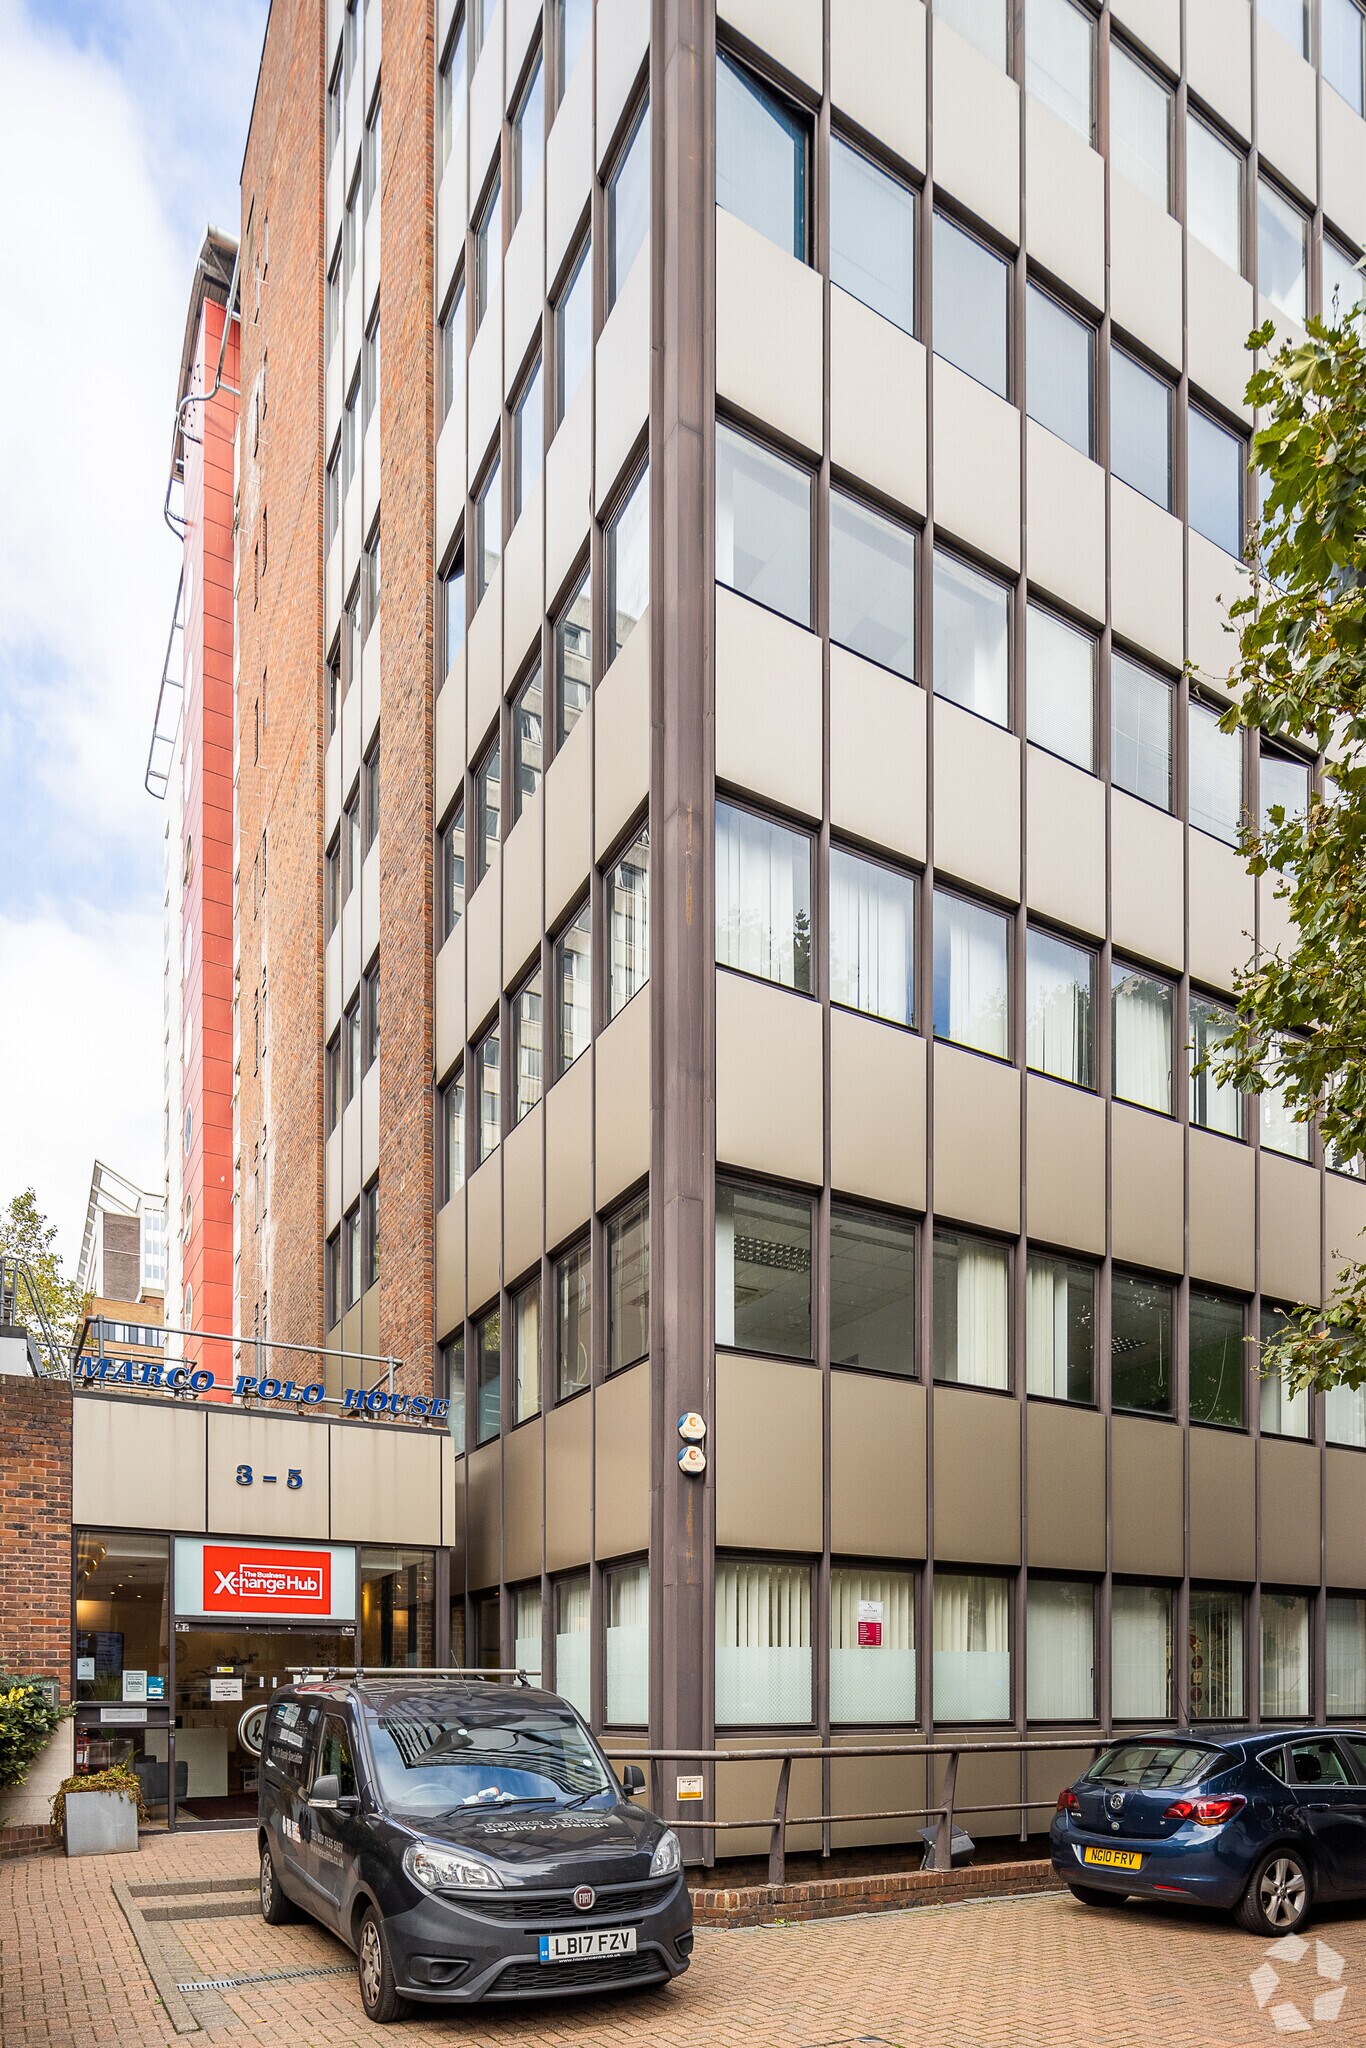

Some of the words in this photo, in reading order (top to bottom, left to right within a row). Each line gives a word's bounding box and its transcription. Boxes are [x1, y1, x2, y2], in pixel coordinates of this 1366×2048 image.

[77, 1356, 215, 1392] MARCO
[232, 1374, 326, 1405] POLO
[342, 1388, 451, 1419] HOUSE
[235, 1464, 254, 1486] 3
[286, 1468, 304, 1490] 5
[213, 1570, 286, 1595] Xchange
[286, 1575, 318, 1591] Hub
[476, 1820, 544, 1830] Telco
[484, 1825, 537, 1834] Quality
[541, 1823, 558, 1831] by
[1091, 1848, 1112, 1863] NG10
[1113, 1851, 1136, 1866] FRV
[579, 1892, 592, 1904] FIAT
[555, 1936, 594, 1956] LB17
[598, 1932, 630, 1952] FZV
